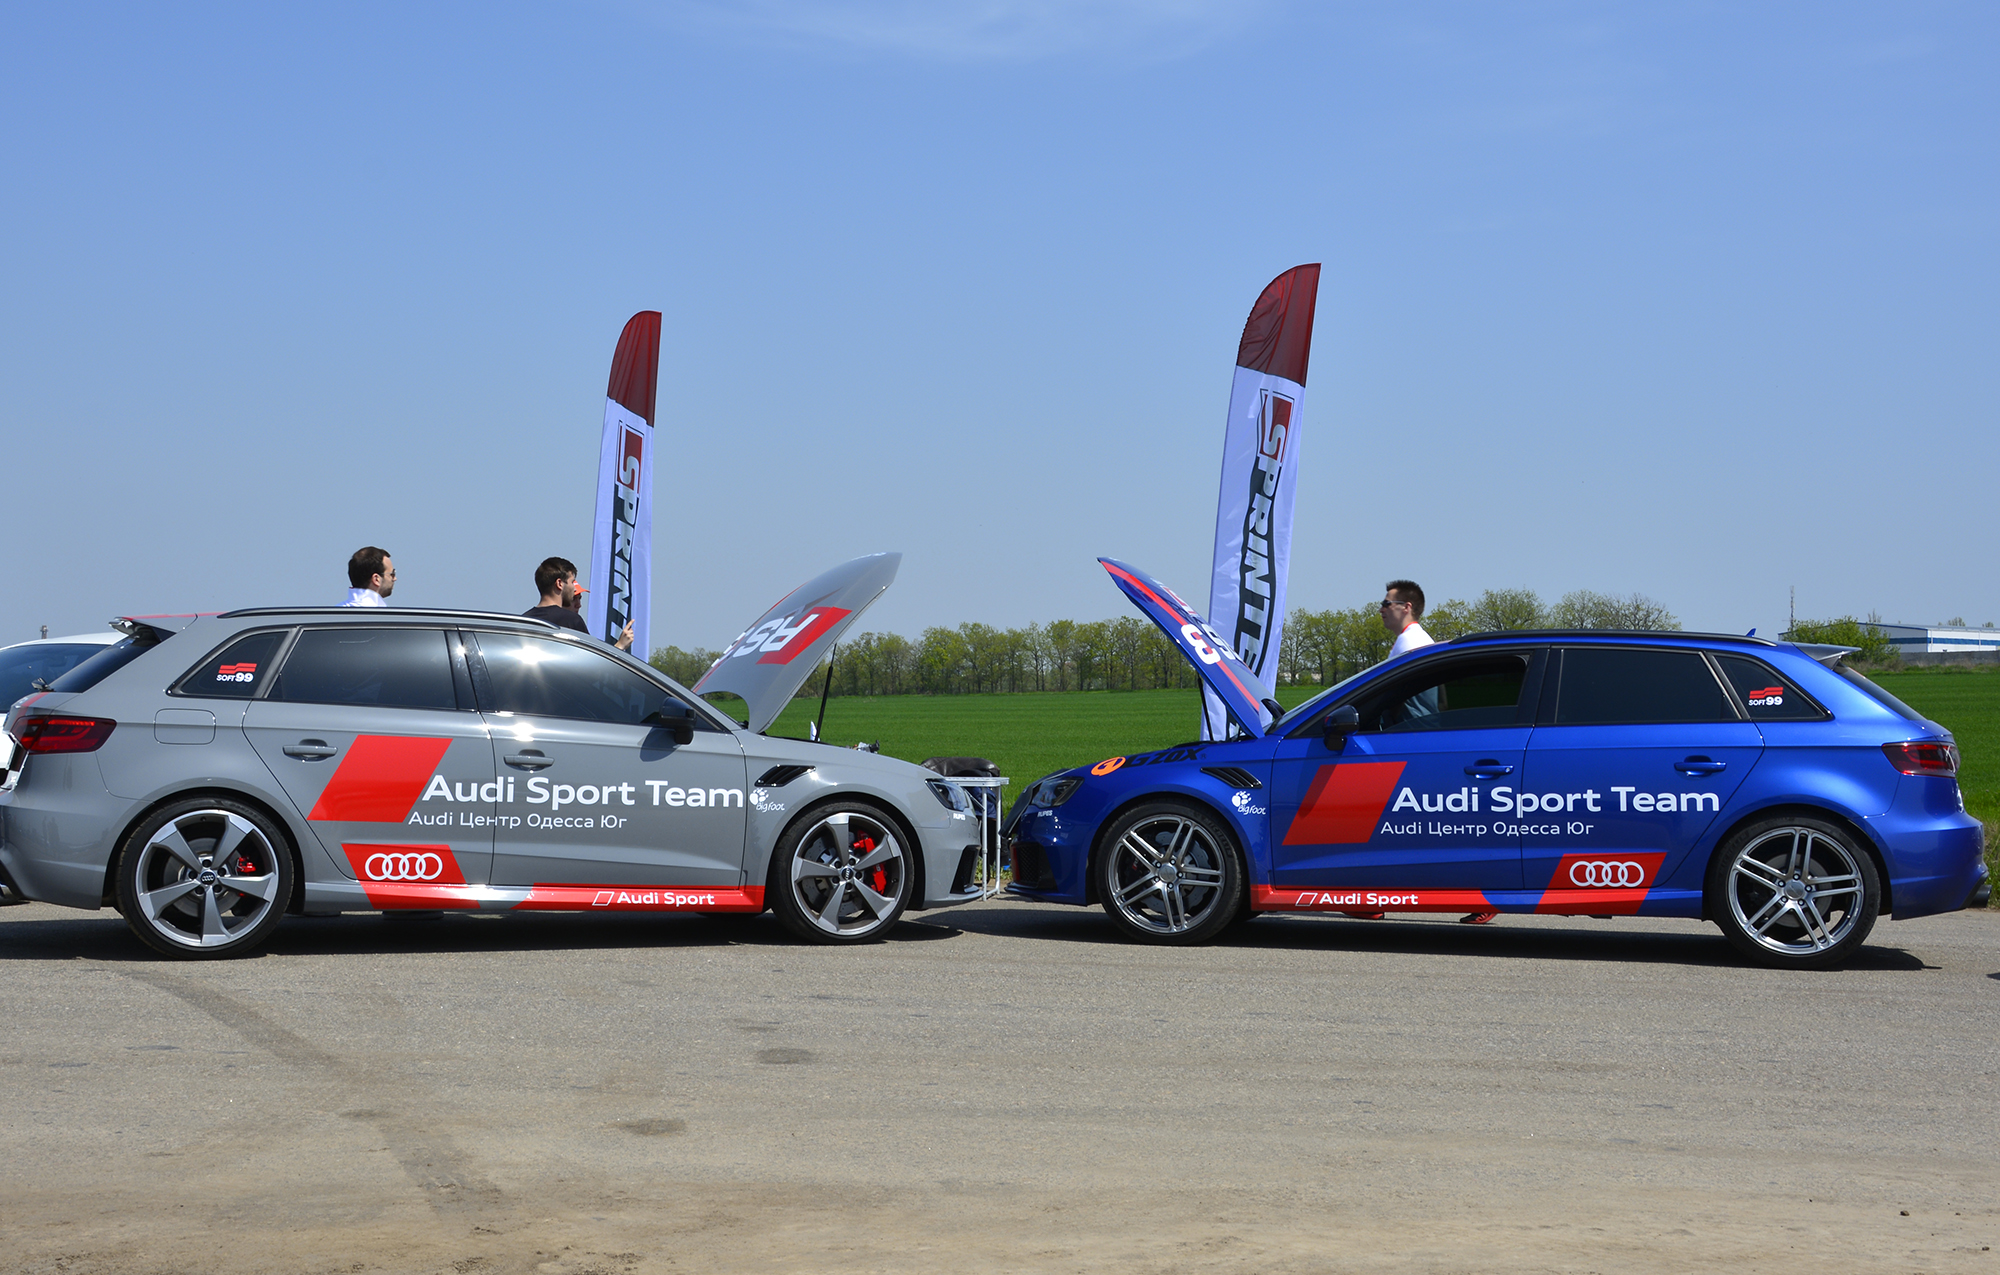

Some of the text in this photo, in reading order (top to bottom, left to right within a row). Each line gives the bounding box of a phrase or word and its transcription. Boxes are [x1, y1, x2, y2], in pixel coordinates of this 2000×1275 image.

[216, 672, 254, 683] SOFT99
[1748, 696, 1783, 706] SOFT99
[422, 774, 744, 811] Audi Sport Team
[1392, 786, 1720, 818] Audi Sport Team
[408, 811, 627, 830] Audi Центр Одесса Юг
[1380, 821, 1594, 837] Audi Центр Одесса Юг
[616, 891, 715, 907] Audi Sport
[1319, 892, 1419, 906] Audi Sport
